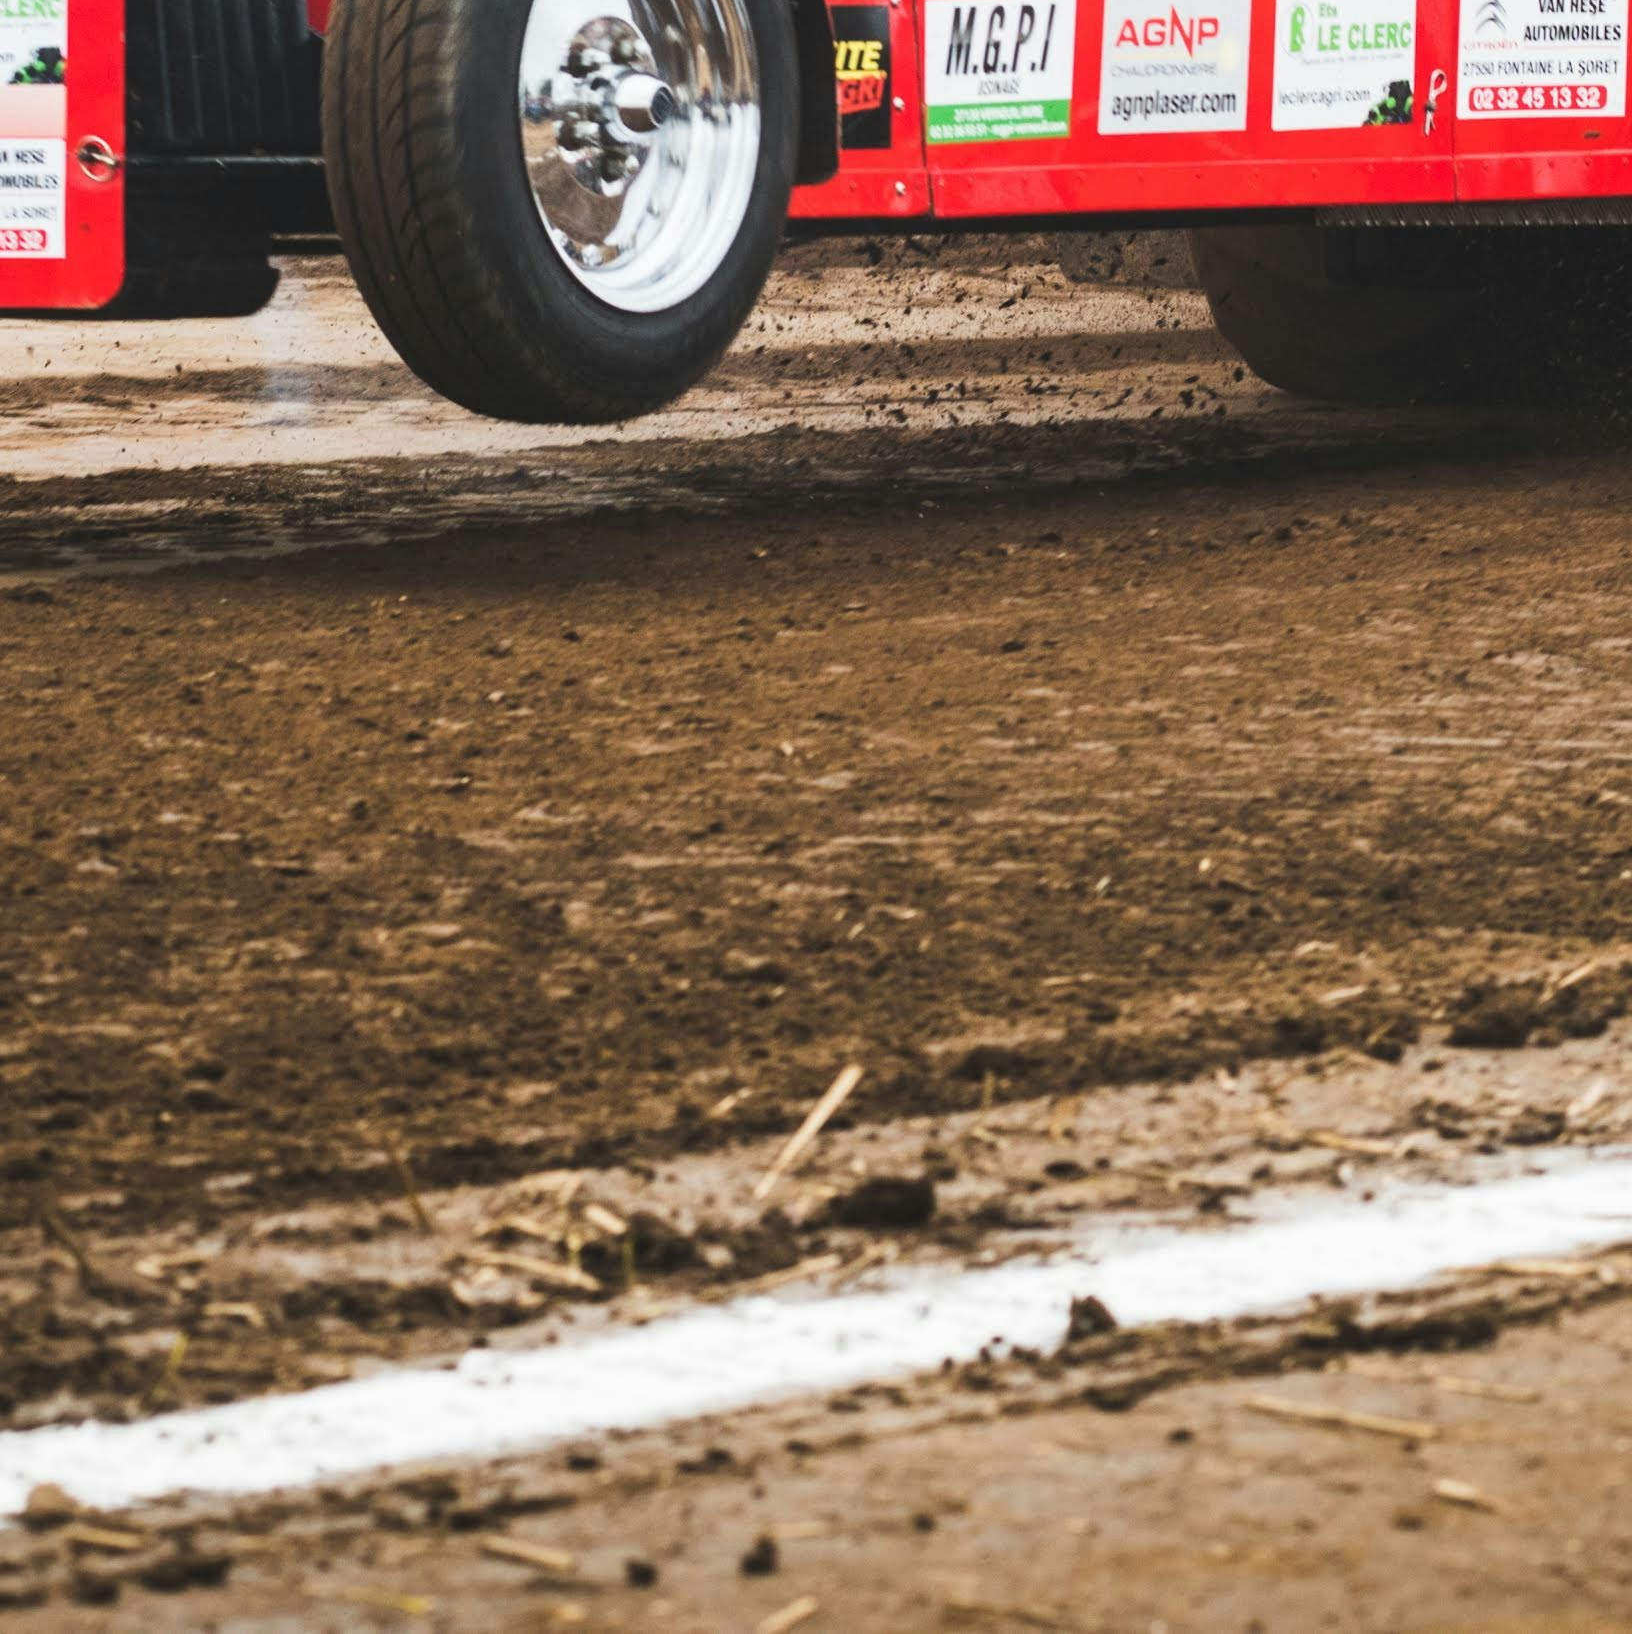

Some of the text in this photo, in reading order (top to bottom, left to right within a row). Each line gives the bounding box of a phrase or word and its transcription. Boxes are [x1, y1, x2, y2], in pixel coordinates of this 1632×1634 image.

[945, 4, 1056, 76] M.G.P.I
[1115, 5, 1219, 58] AGNP
[1318, 22, 1412, 51] LE CLERC
[1524, 25, 1622, 42] AUTOMOBILES
[1498, 60, 1552, 76] FONTAINE
[1558, 60, 1574, 75] LA
[1578, 59, 1618, 77] SORET
[1112, 89, 1237, 121] agnplaser.com
[1473, 87, 1600, 109] 02 32 45 13 32
